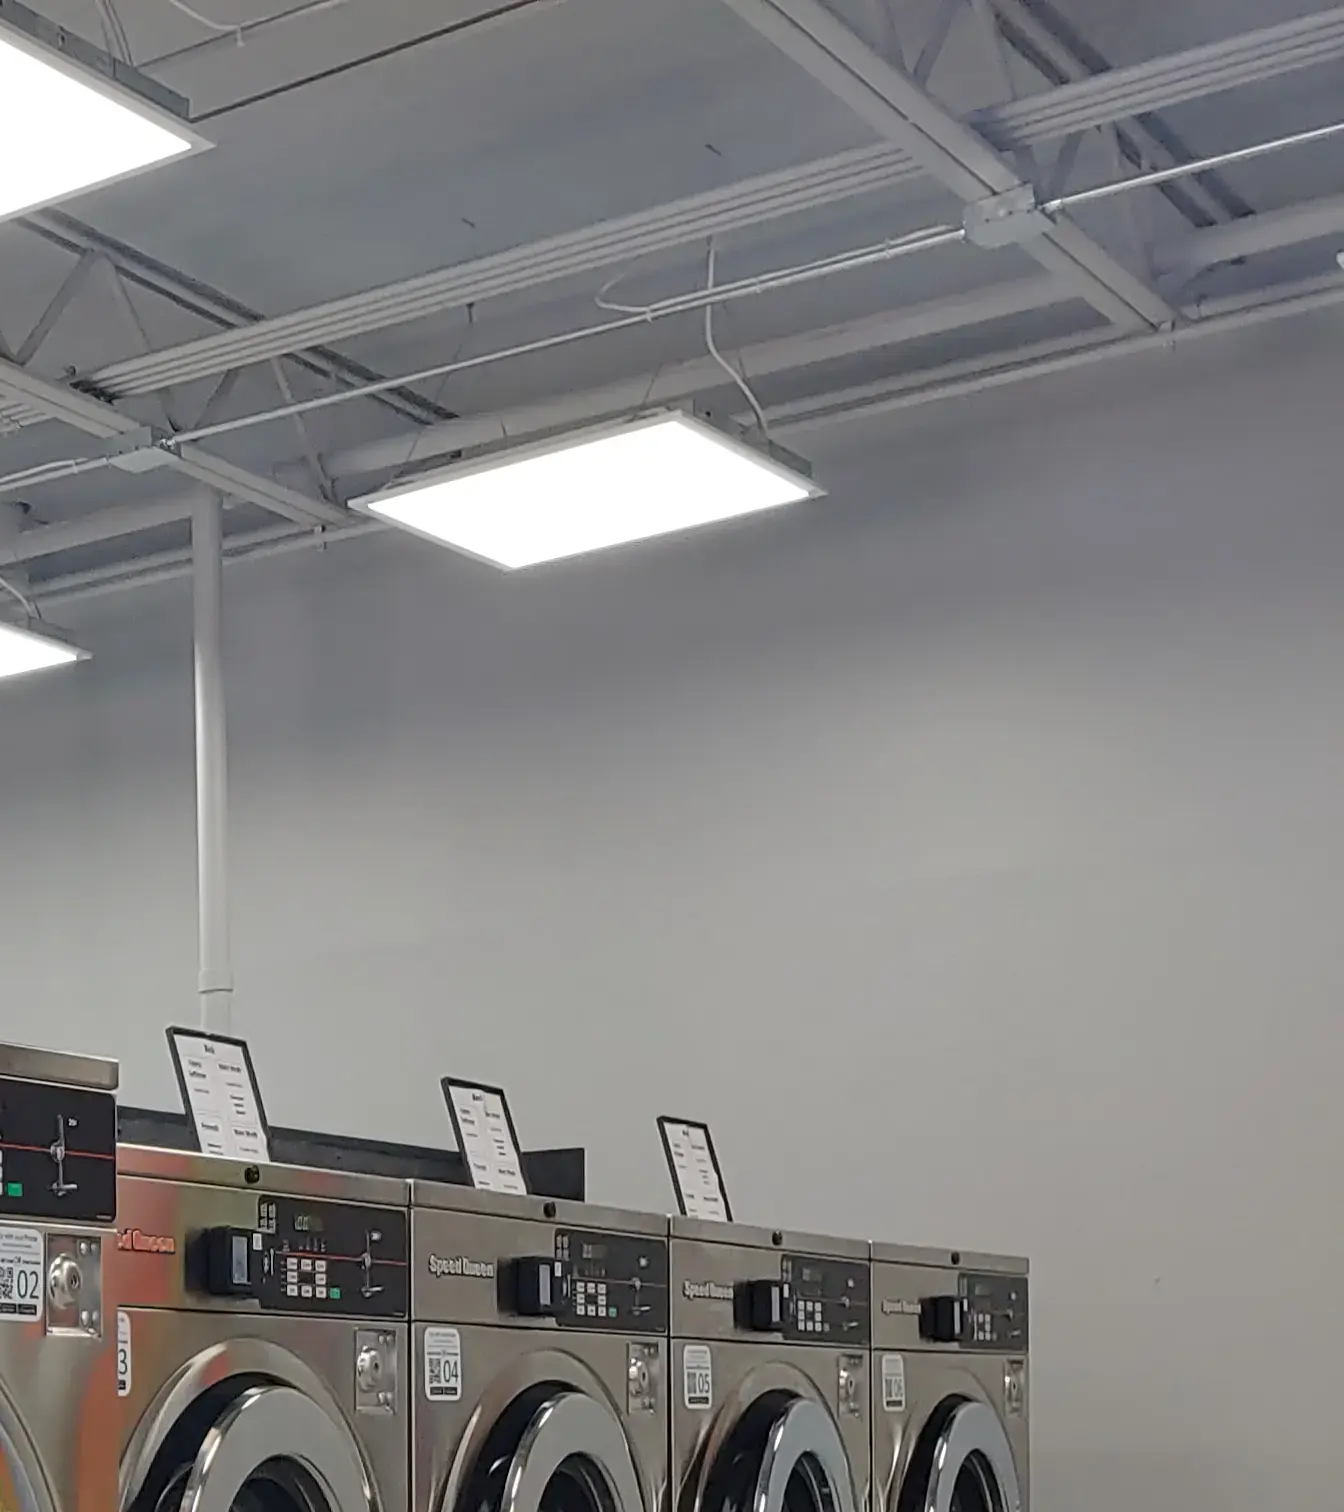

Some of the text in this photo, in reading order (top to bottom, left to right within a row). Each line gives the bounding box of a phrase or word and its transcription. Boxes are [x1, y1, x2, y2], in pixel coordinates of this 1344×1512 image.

[429, 1252, 494, 1278] Speed Queen
[17, 1269, 39, 1299] 02
[117, 1348, 128, 1375] 3
[443, 1359, 459, 1383] 04
[698, 1372, 710, 1394] 05
